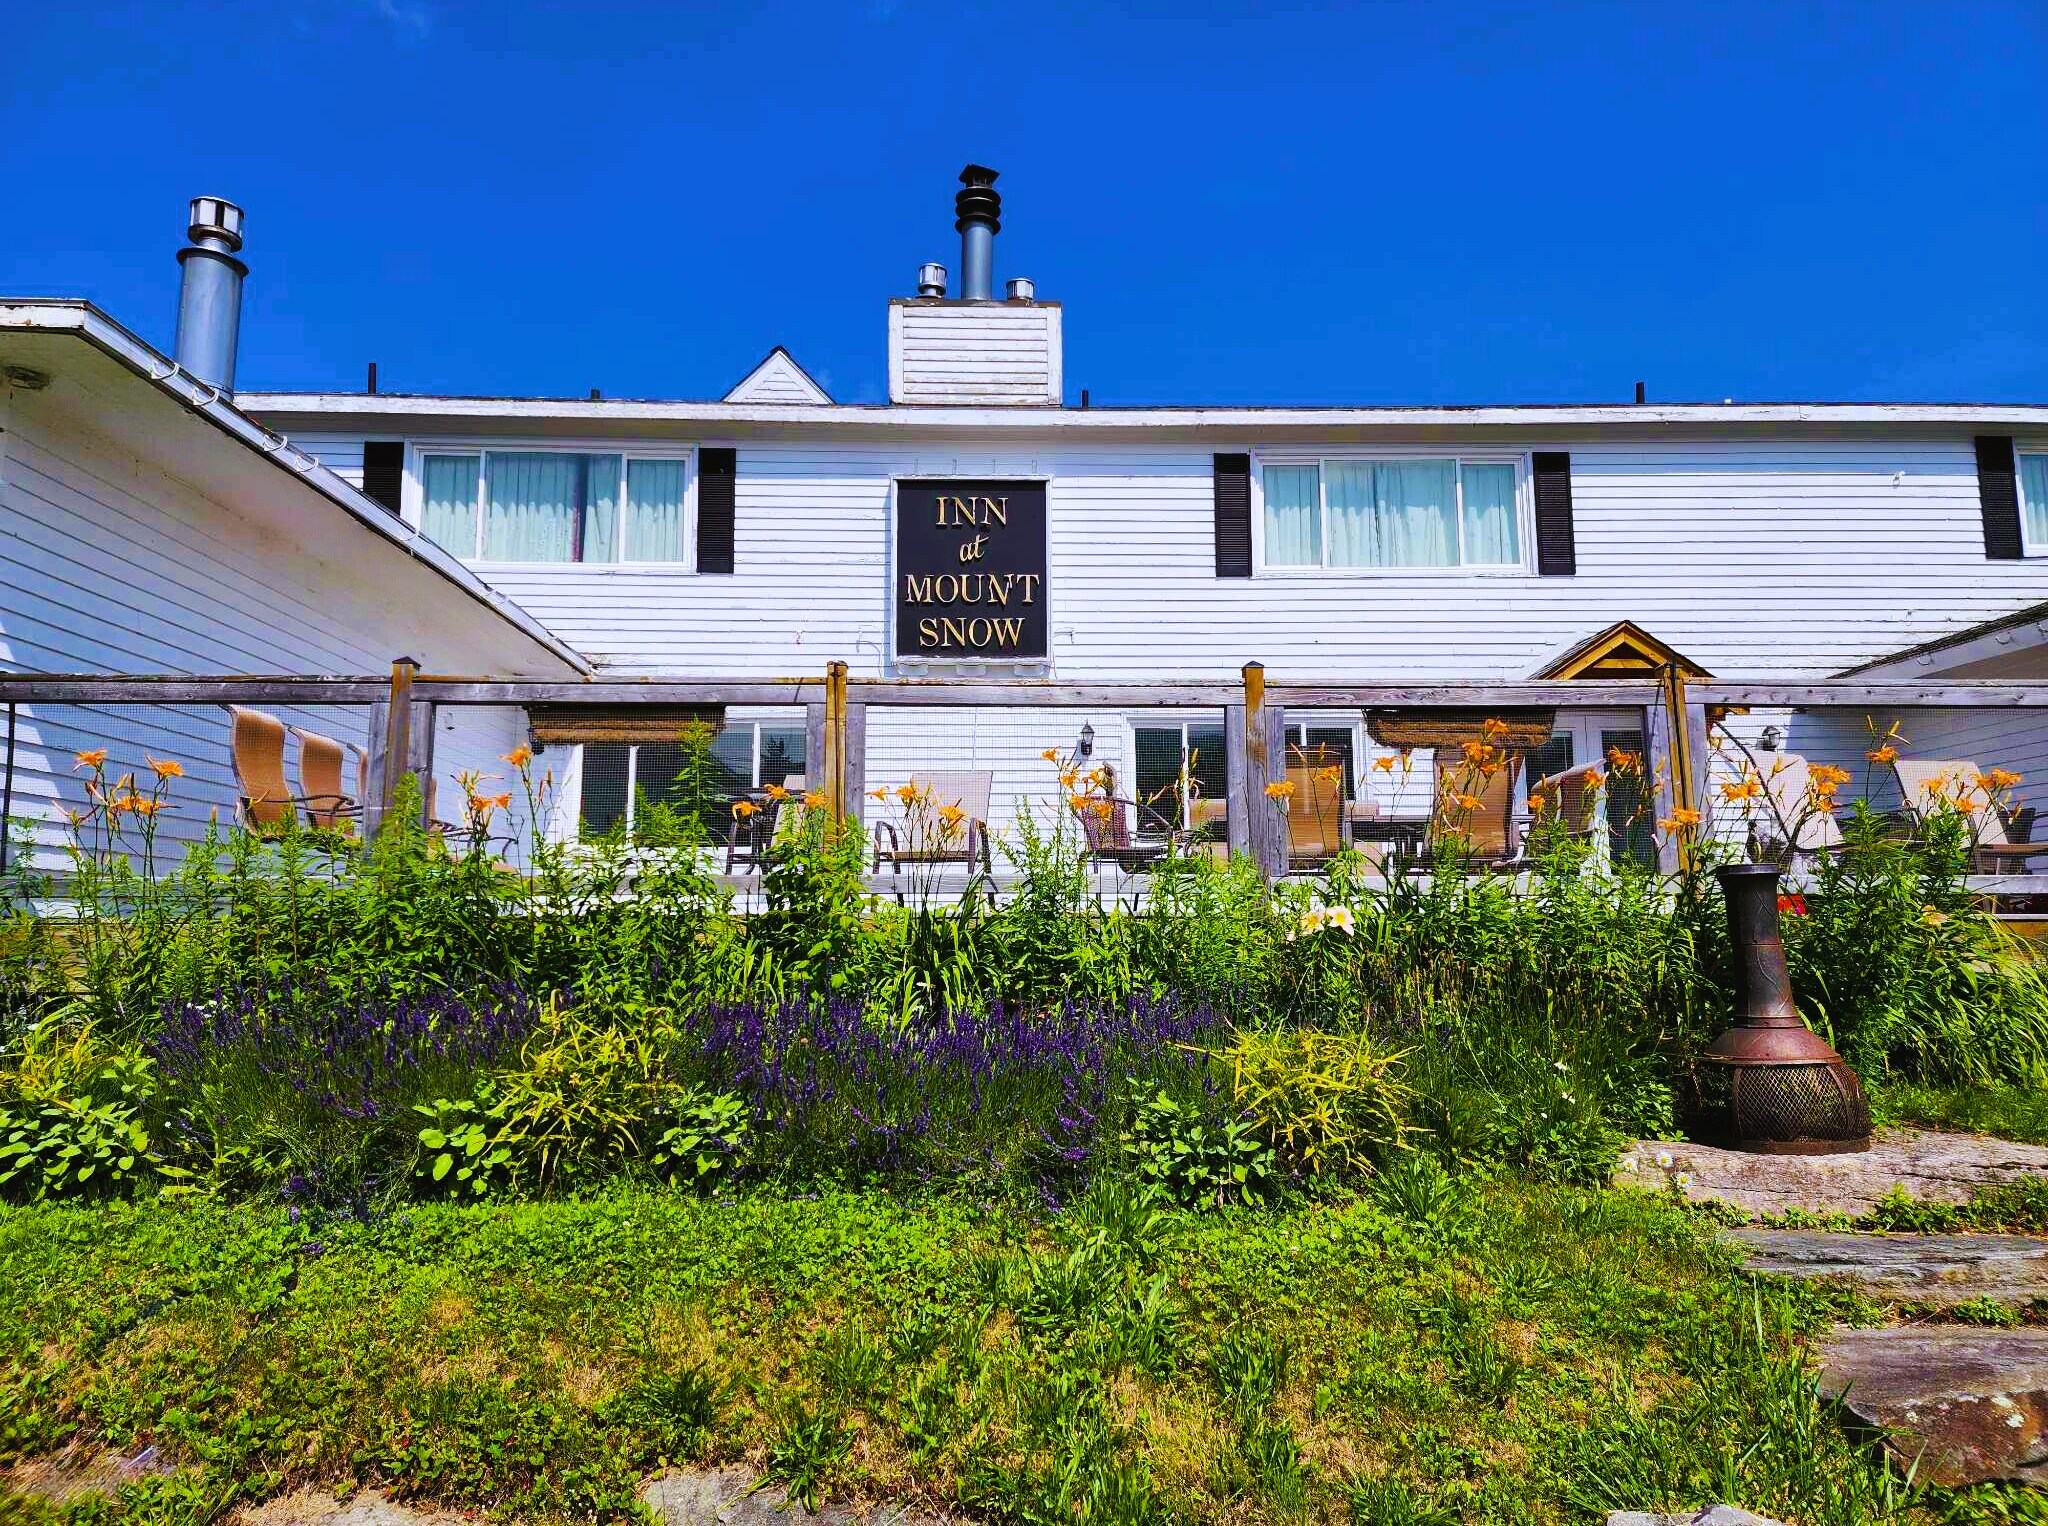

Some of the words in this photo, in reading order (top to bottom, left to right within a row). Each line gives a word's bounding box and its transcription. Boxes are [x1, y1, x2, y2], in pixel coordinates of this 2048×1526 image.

[935, 496, 1009, 526] INN
[959, 533, 990, 562] at
[904, 573, 1040, 606] MOUNT
[919, 617, 1026, 647] SNOW
